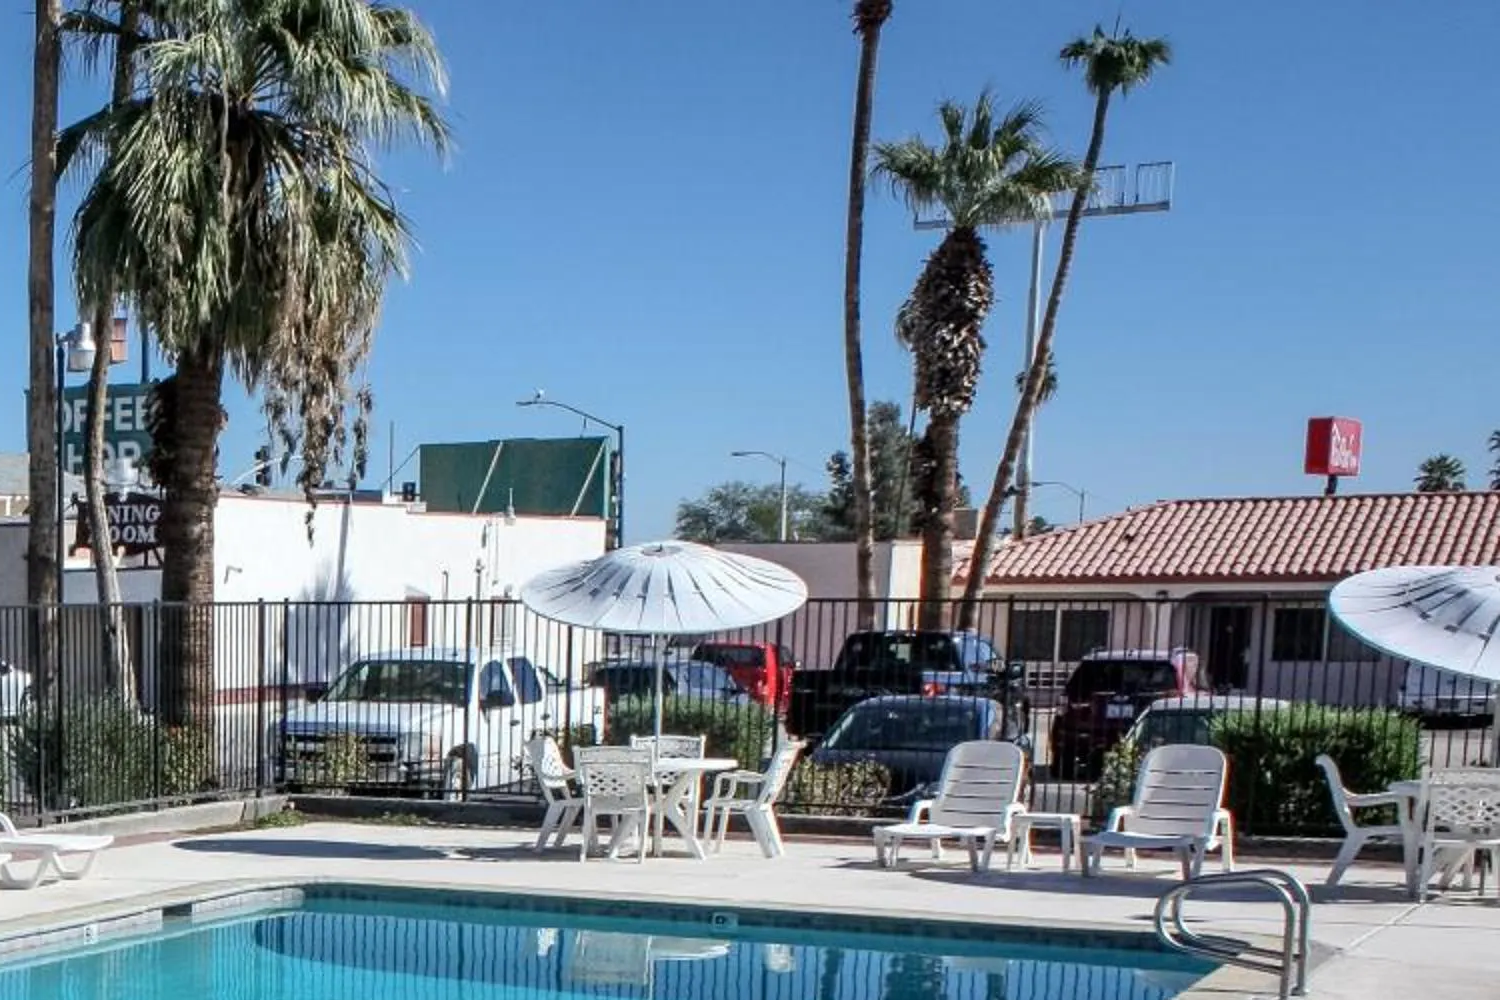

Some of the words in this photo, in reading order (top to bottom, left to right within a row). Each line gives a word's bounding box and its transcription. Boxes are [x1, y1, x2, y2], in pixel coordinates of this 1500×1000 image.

[54, 395, 148, 432] OFEE
[57, 439, 141, 471] HOP
[106, 504, 161, 524] NING
[107, 524, 158, 544] OOM
